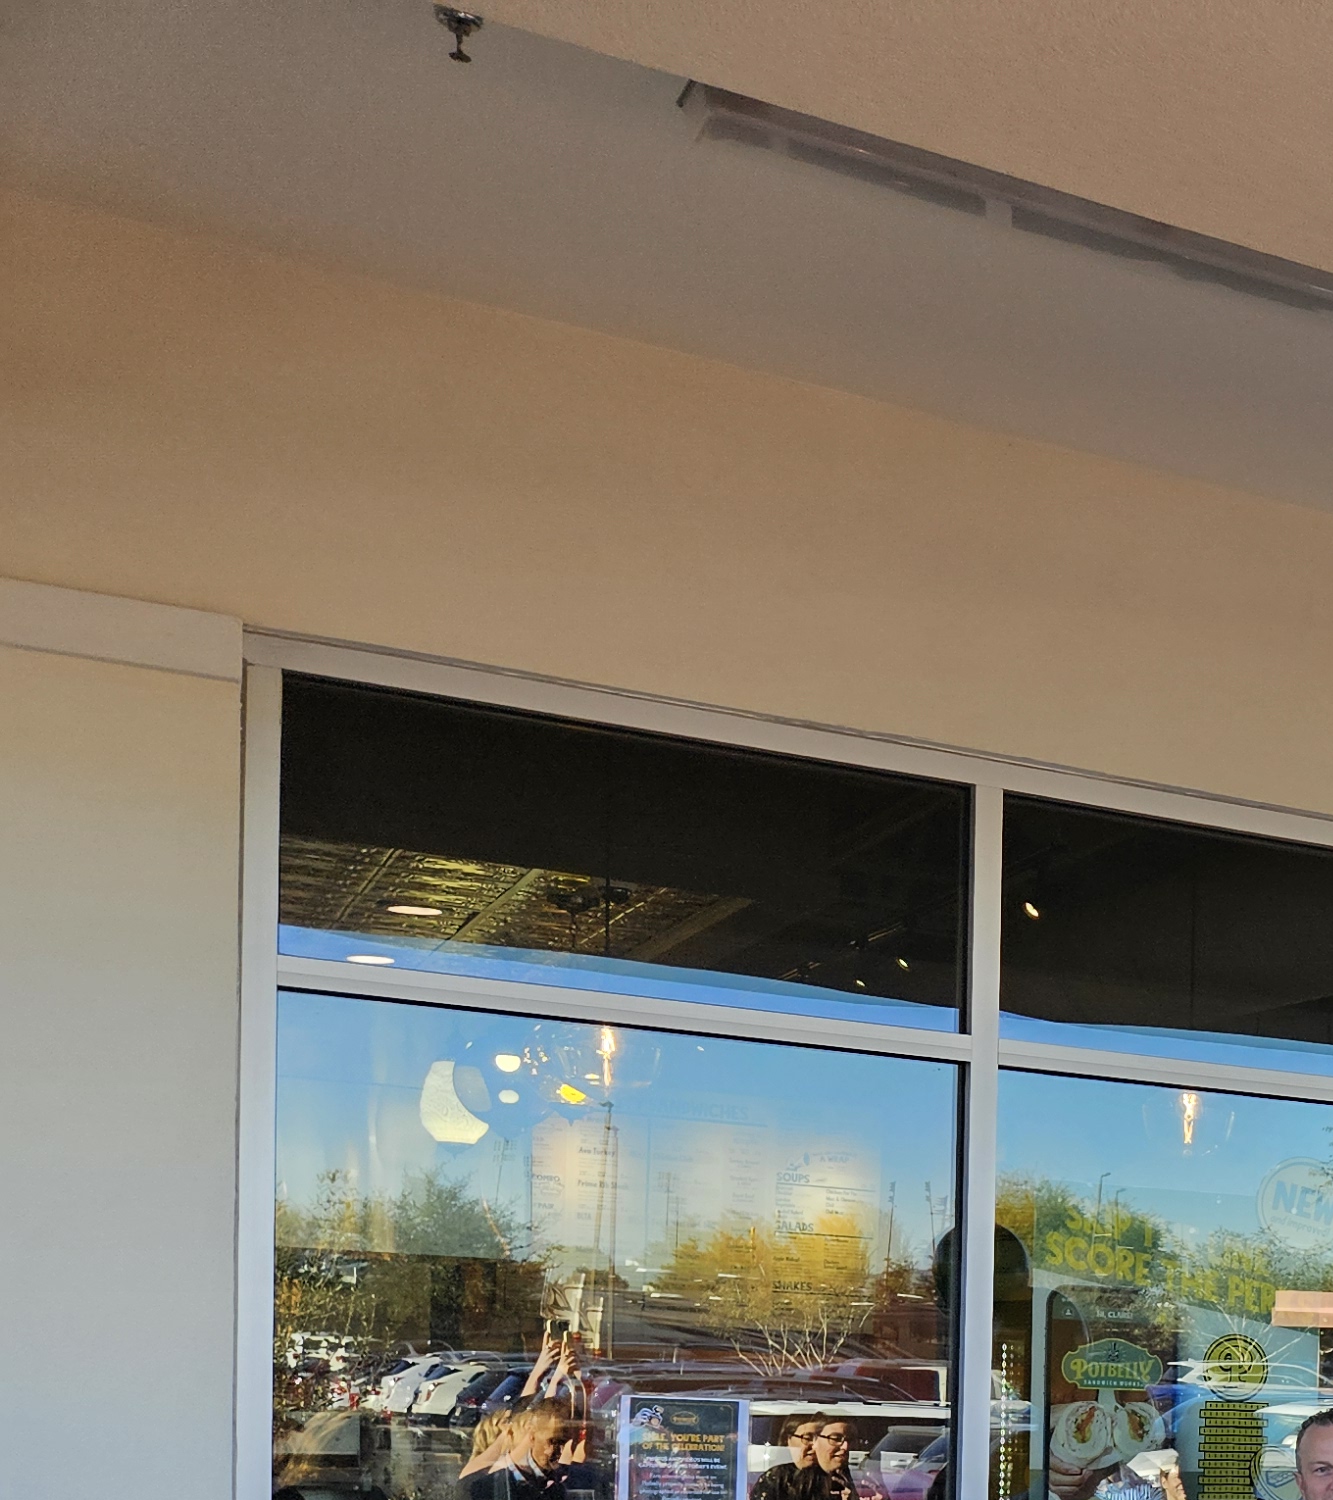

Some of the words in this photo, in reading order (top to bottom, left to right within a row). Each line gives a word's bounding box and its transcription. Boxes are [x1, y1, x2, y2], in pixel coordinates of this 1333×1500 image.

[776, 1171, 810, 1183] SOUPS
[775, 1220, 814, 1232] SALADS
[1046, 1231, 1152, 1286] SCORE
[772, 1280, 813, 1291] SHAKES
[1070, 1359, 1154, 1383] POTBELLY
[703, 1434, 725, 1443] PART
[642, 1442, 653, 1450] OF
[655, 1442, 670, 1450] THE
